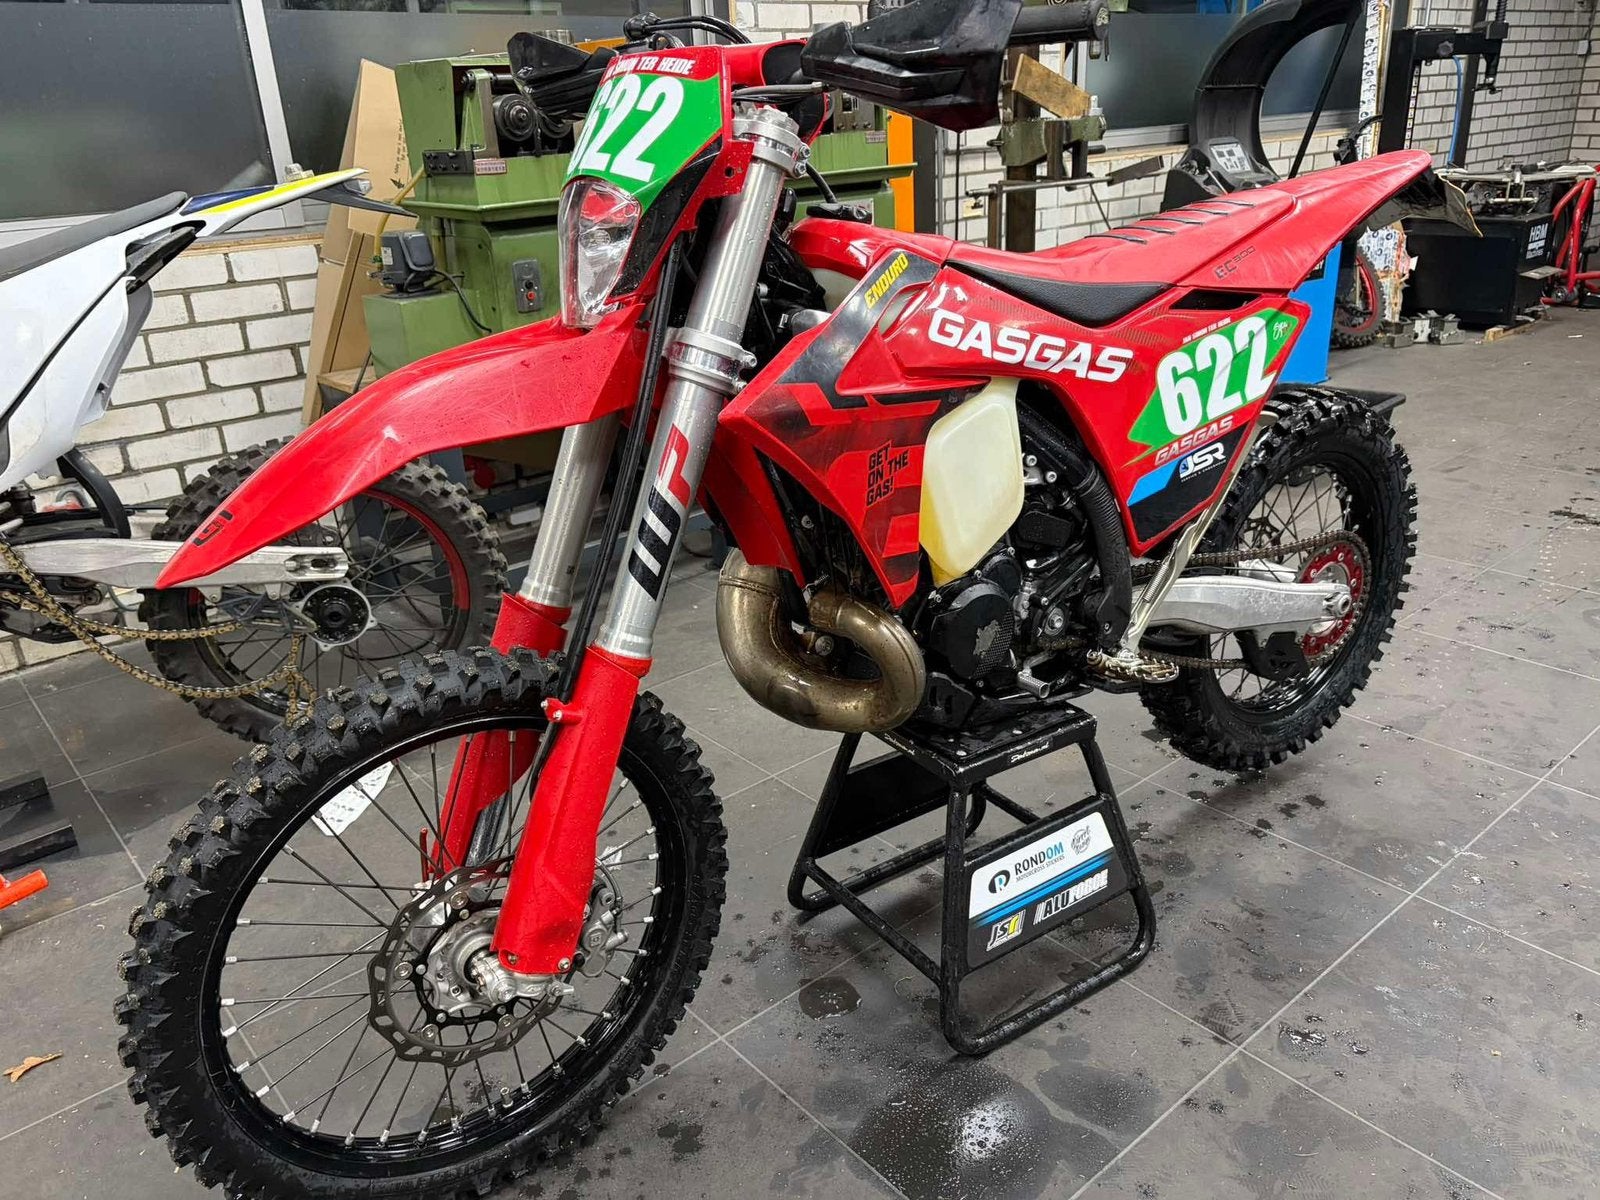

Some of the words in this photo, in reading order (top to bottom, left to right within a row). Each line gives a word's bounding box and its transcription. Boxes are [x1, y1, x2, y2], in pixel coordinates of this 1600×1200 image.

[636, 56, 660, 71] TER
[656, 57, 696, 75] HEIDE
[864, 252, 909, 309] ENDURO
[928, 308, 1134, 383] GASGAS
[1156, 316, 1277, 436] 622
[869, 443, 891, 471] GET
[1155, 415, 1234, 467] GASGAS
[868, 465, 884, 489] ON
[888, 450, 909, 475] THE
[1179, 442, 1227, 479] JSR
[866, 476, 894, 507] GAS!
[1014, 841, 1065, 876] RONDOM
[1042, 889, 1071, 918] ALU
